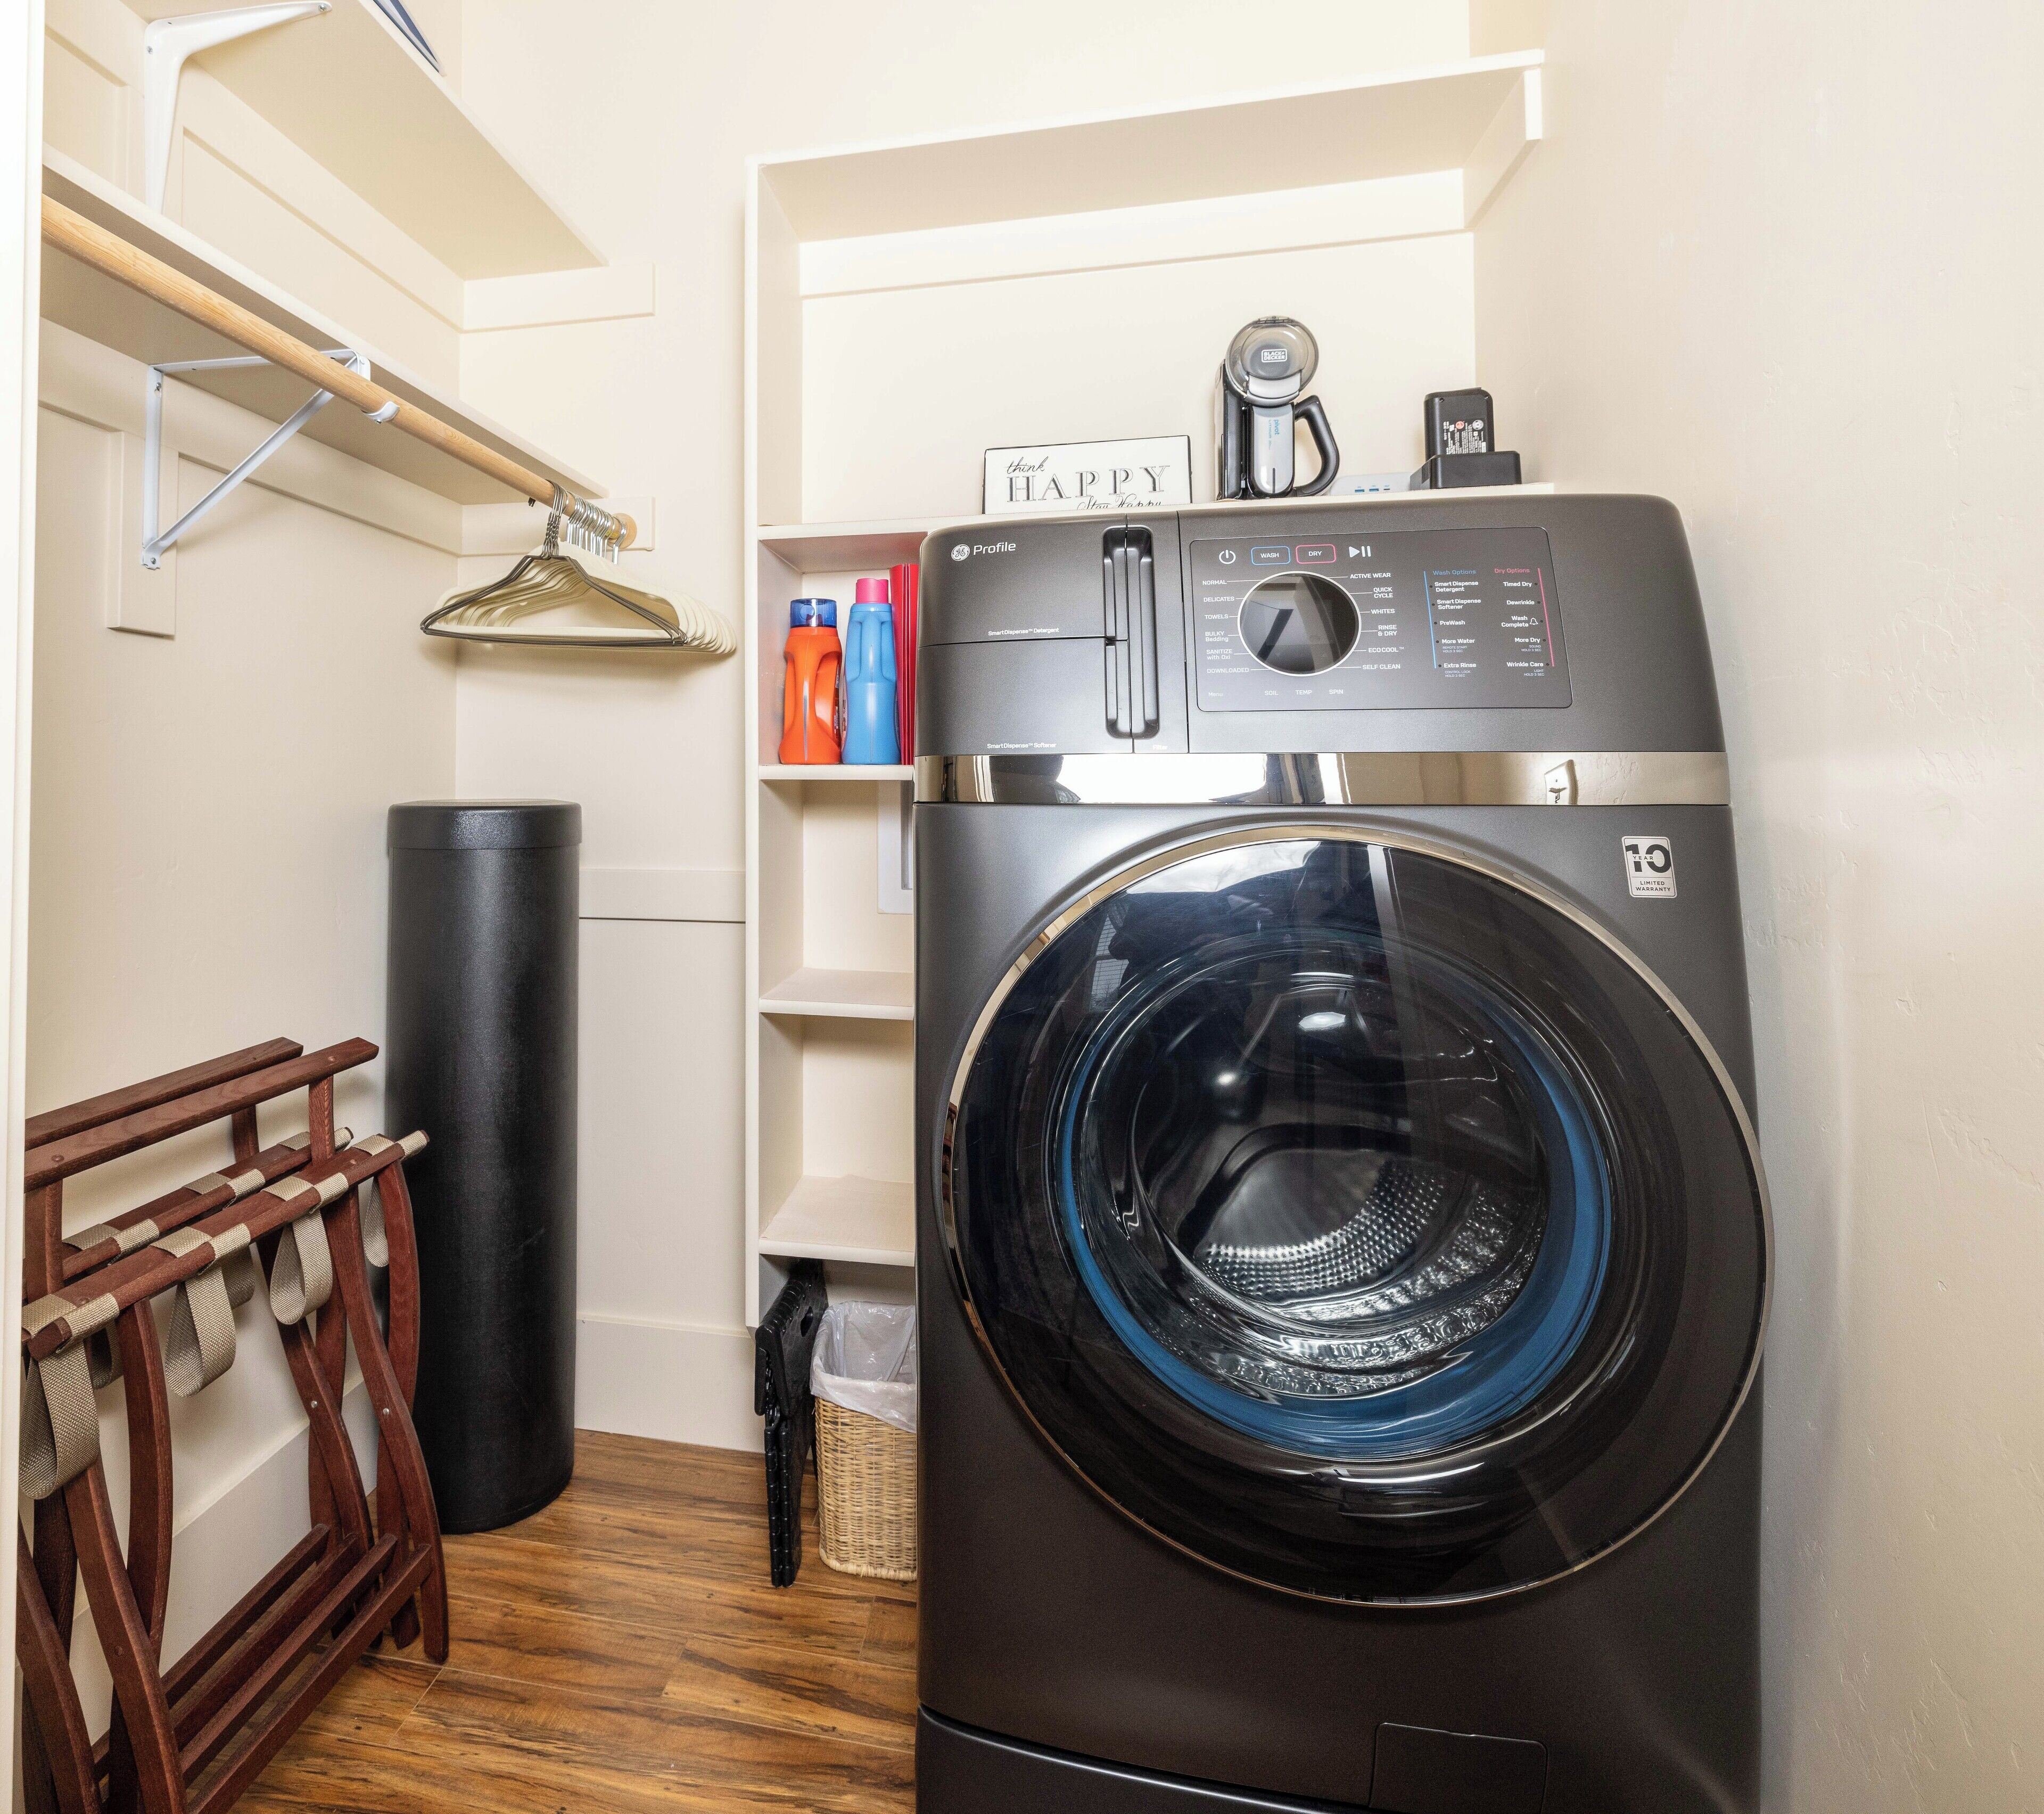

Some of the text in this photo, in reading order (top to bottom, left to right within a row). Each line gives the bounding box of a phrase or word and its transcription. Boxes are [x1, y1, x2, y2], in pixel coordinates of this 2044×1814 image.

[1004, 456, 1049, 474] think
[1006, 465, 1170, 503] HAPPY
[974, 542, 1016, 555] Profile
[1625, 844, 1672, 873] 10
